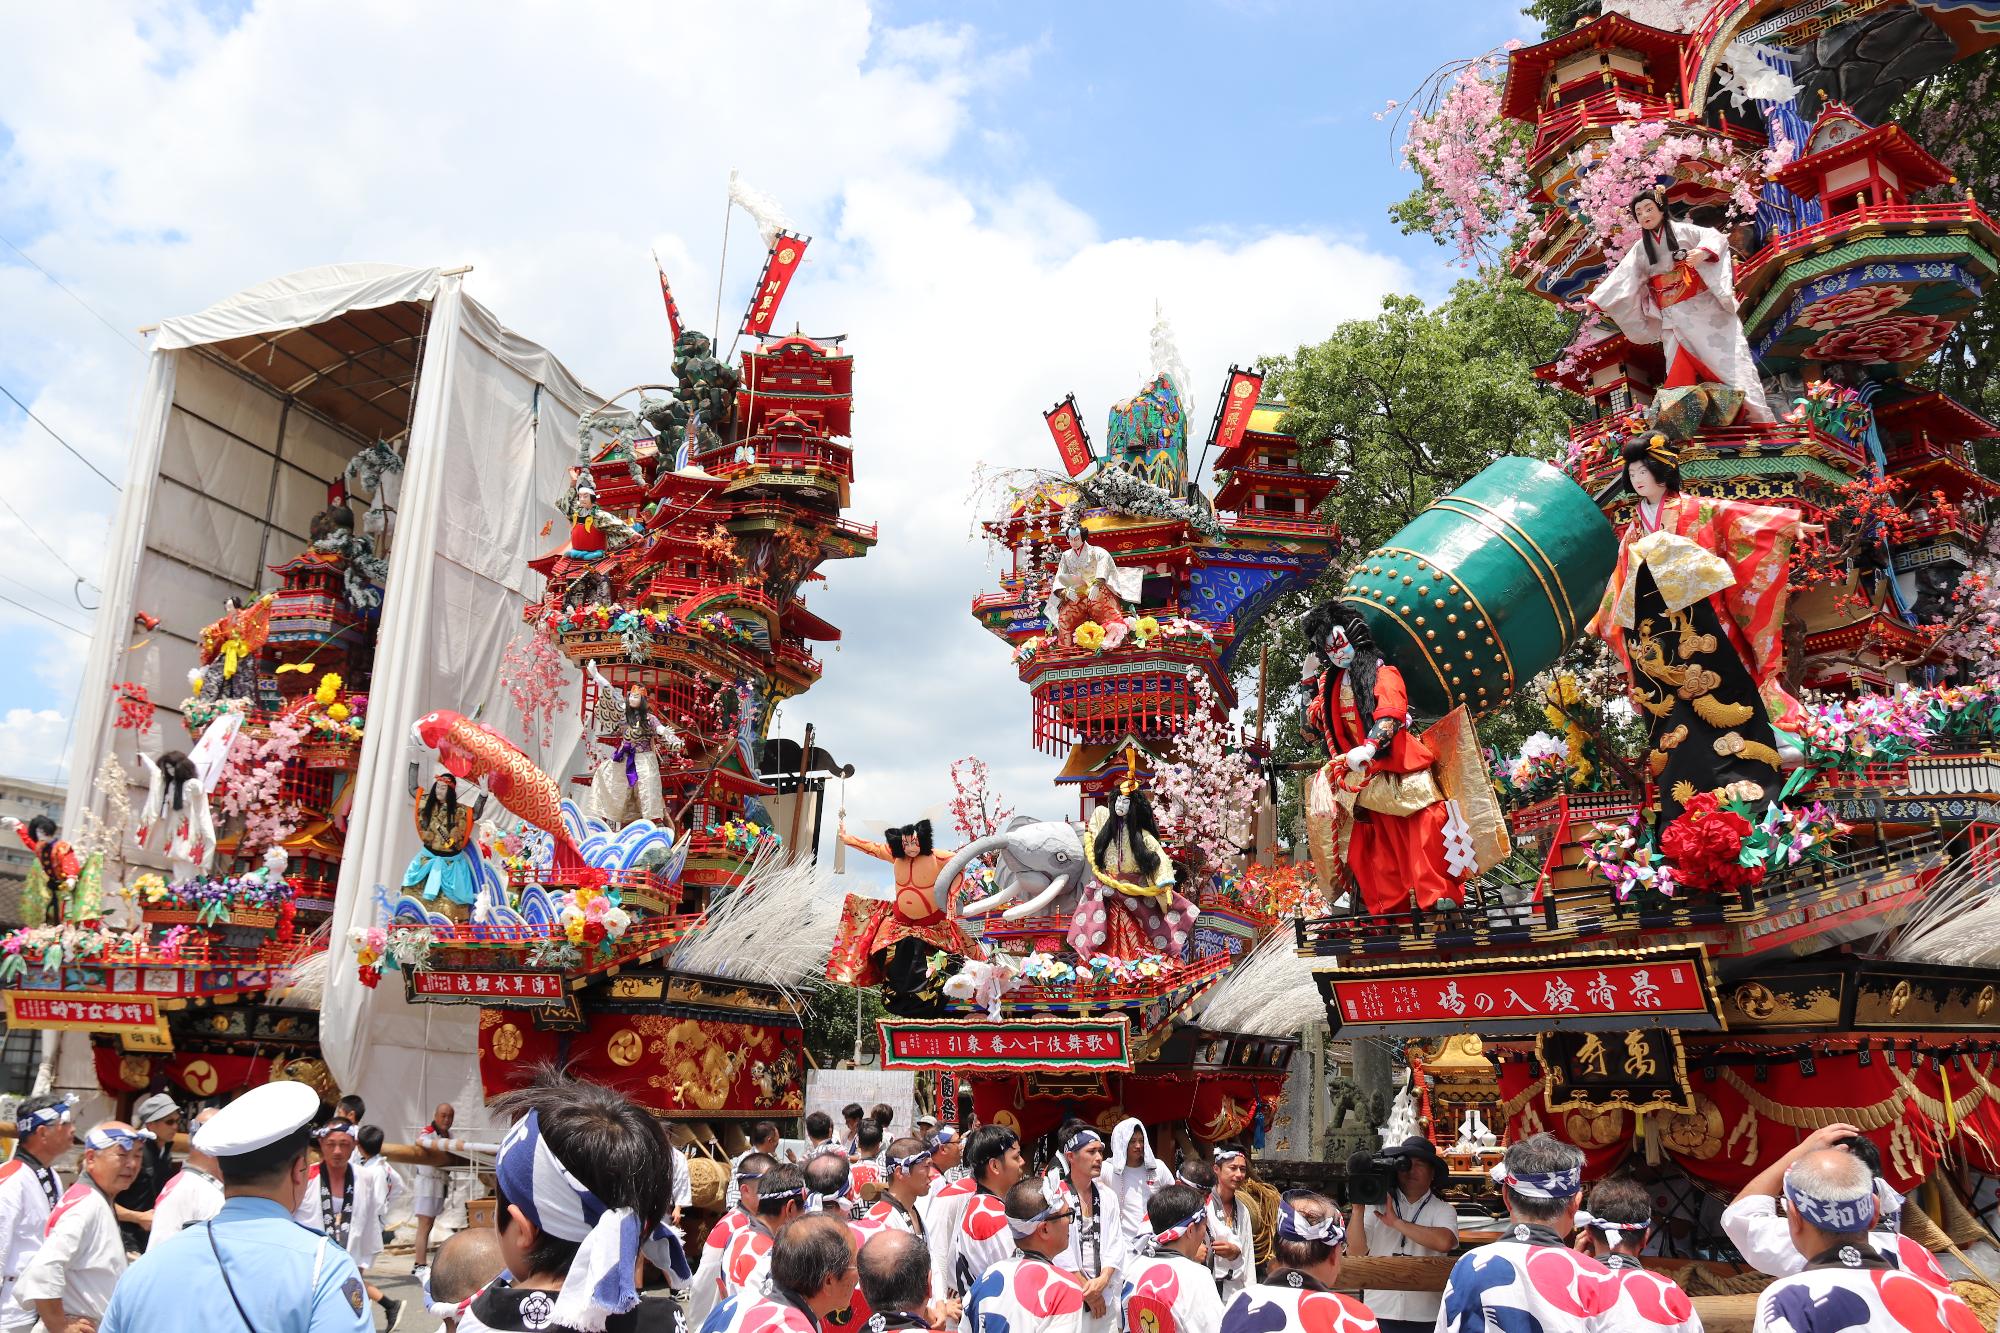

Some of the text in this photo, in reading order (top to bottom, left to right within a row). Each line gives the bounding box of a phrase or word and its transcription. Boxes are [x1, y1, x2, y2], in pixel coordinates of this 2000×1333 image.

[1224, 400, 1243, 442] 三隈町
[1063, 430, 1084, 464] 三隈町
[1437, 969, 1661, 1014] 景清鐘入の場
[940, 1071, 956, 1120] 園祭
